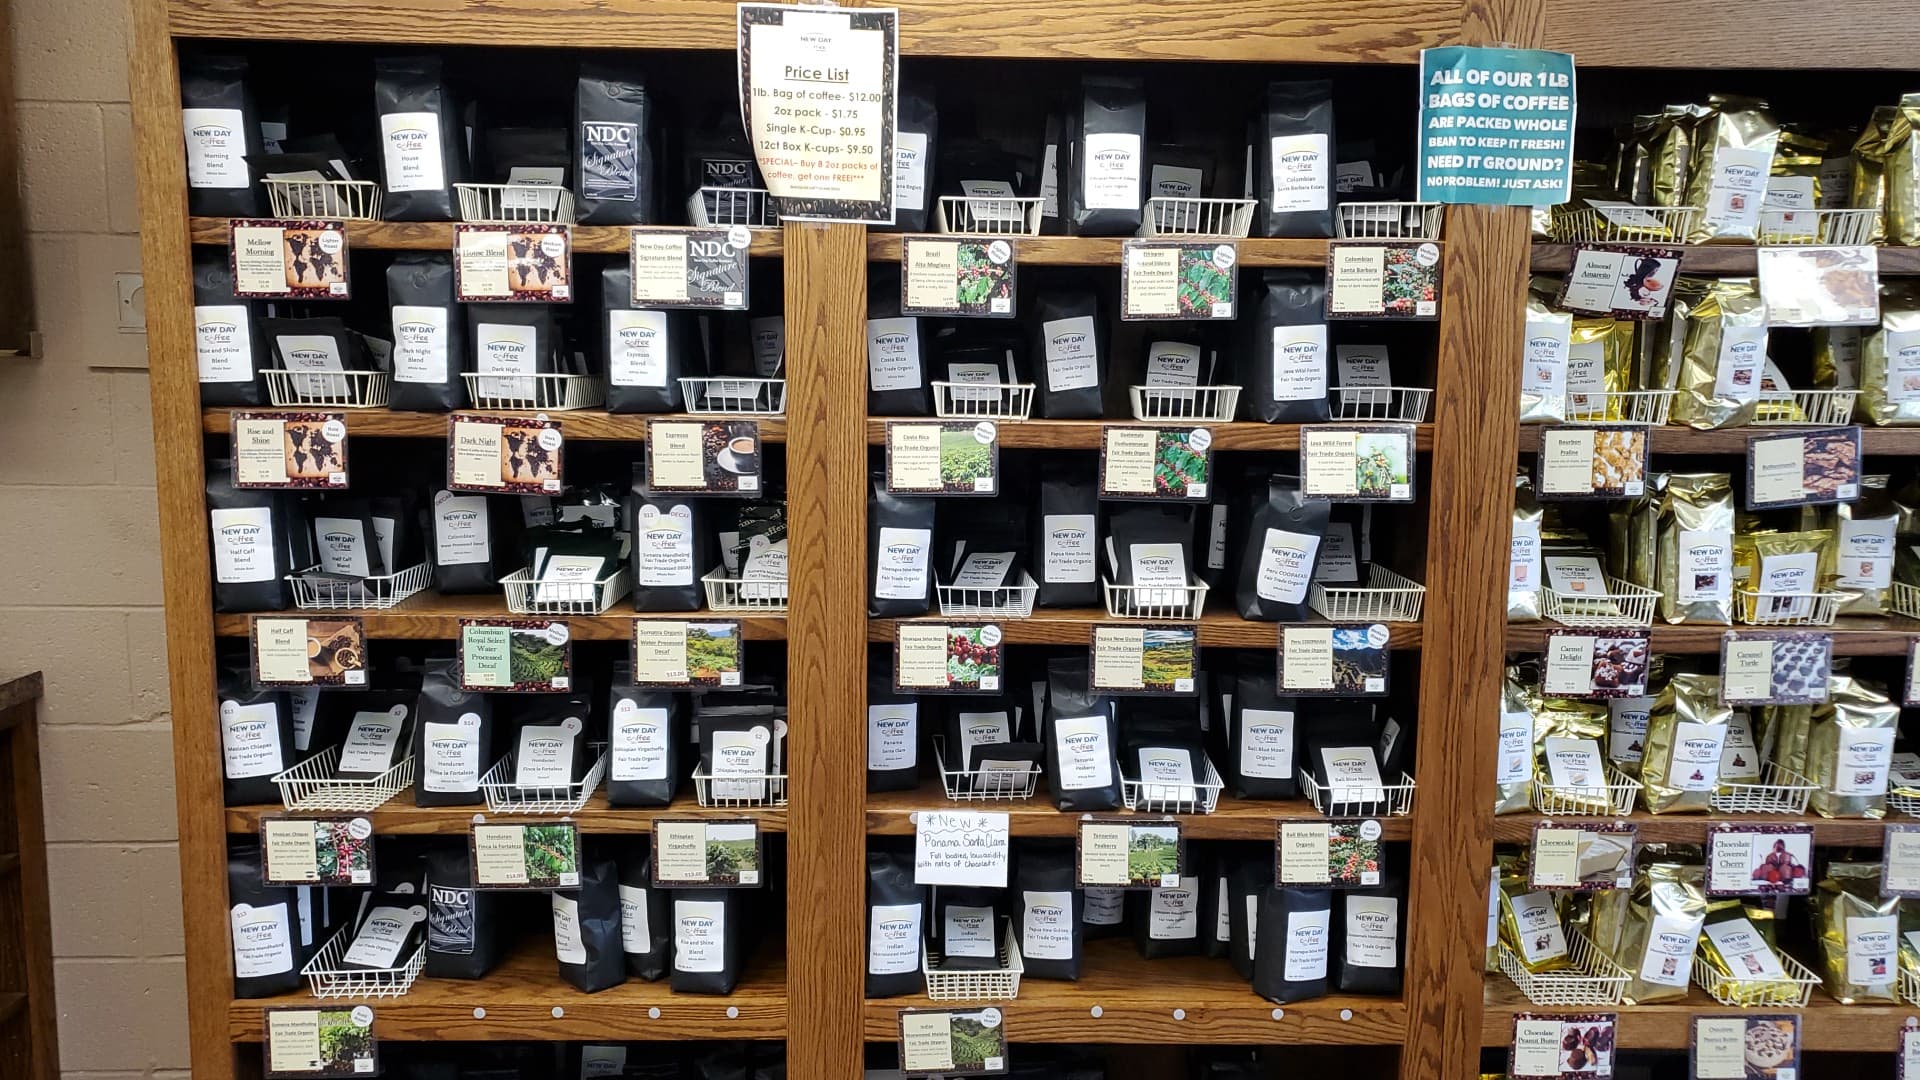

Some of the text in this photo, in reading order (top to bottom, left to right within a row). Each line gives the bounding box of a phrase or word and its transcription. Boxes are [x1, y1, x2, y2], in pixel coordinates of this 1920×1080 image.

[785, 65, 850, 81] Price List
[1430, 69, 1464, 85] ALL
[1466, 69, 1489, 85] OF
[1493, 71, 1532, 87] OUR
[753, 87, 770, 97] 1lb.
[773, 88, 793, 100] Bag
[796, 89, 806, 99] of
[849, 92, 881, 103] $12.00
[1429, 92, 1569, 110] BAGS OF COFFEE
[774, 106, 792, 116] 2oz
[795, 107, 822, 118] pack
[832, 109, 859, 119] $1.75
[1429, 116, 1567, 131] ARE PACKED WHOLE
[213, 129, 231, 137] DAY
[587, 126, 631, 143] NDC
[766, 123, 797, 135] Single
[839, 126, 866, 137] $0.95
[390, 133, 410, 141] NEW
[1429, 136, 1565, 150] BEAN TO KEEP IT FRESH!
[760, 140, 780, 151] 12ct
[782, 141, 801, 152] Box
[847, 144, 873, 155] $9.50
[585, 148, 634, 168] Signature
[1427, 155, 1564, 171] NEED IT GROUND?
[600, 165, 633, 177] Blend
[706, 162, 747, 174] NDC
[800, 159, 814, 169] Buy
[825, 160, 840, 168] 2oz
[841, 162, 867, 172] packs
[869, 162, 879, 170] of
[797, 172, 812, 182] get
[1502, 178, 1531, 189] JUST
[1532, 178, 1563, 189] ASK!
[246, 248, 275, 257] Morning
[690, 240, 736, 257] NDC
[1585, 262, 1611, 270] Almond
[688, 261, 737, 286] Signature
[1581, 270, 1611, 279] Amaretto
[699, 277, 735, 292] Blend
[875, 337, 893, 345] NEW
[1303, 345, 1319, 353] DAY
[460, 436, 496, 446] Dark Night
[906, 547, 920, 555] DAY
[1271, 548, 1307, 560] NEW DAY
[250, 723, 267, 731] DAY
[924, 833, 960, 847] Panama
[1715, 840, 1750, 848] Chocolate
[930, 851, 942, 859] Full
[917, 860, 931, 868] with
[1719, 860, 1744, 869] Cherry
[432, 888, 469, 905] NDC
[430, 909, 472, 925] Signature
